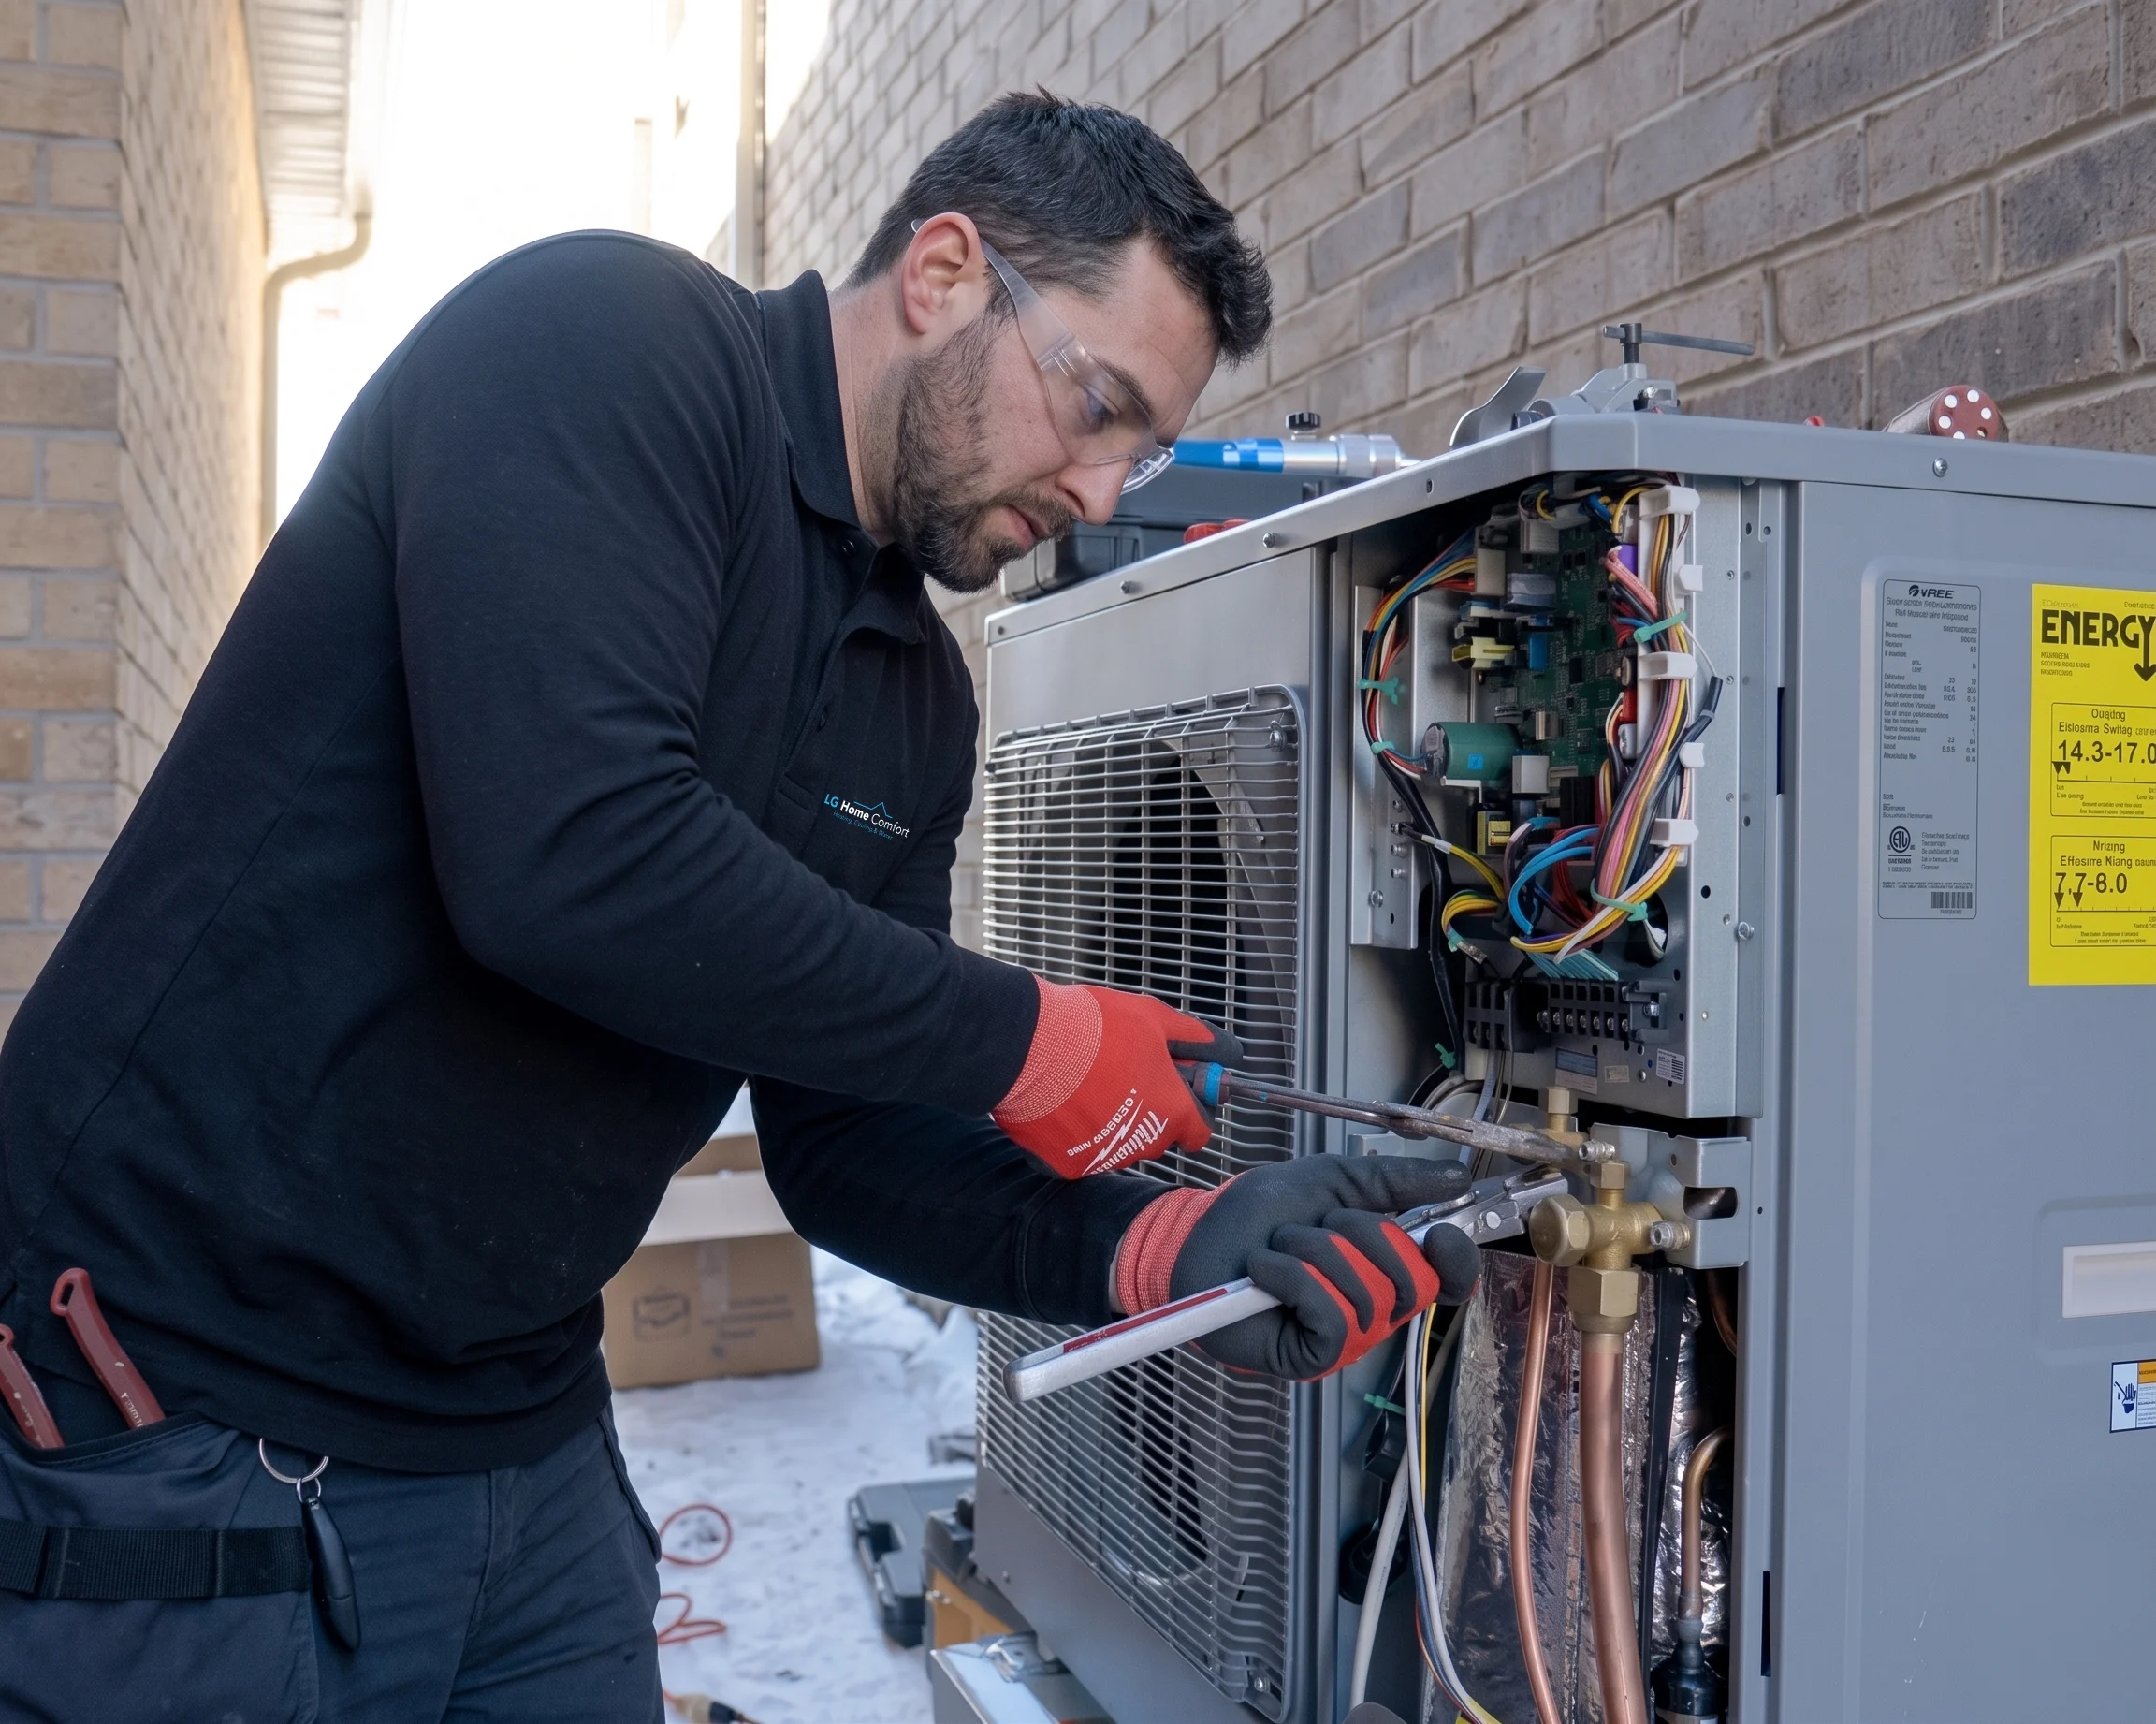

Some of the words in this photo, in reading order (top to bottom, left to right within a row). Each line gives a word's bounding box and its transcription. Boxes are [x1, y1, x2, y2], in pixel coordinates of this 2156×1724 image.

[2041, 609, 2156, 663] ENERGY
[823, 794, 839, 808] LG
[840, 800, 870, 821] Home
[870, 813, 910, 838] Comfort
